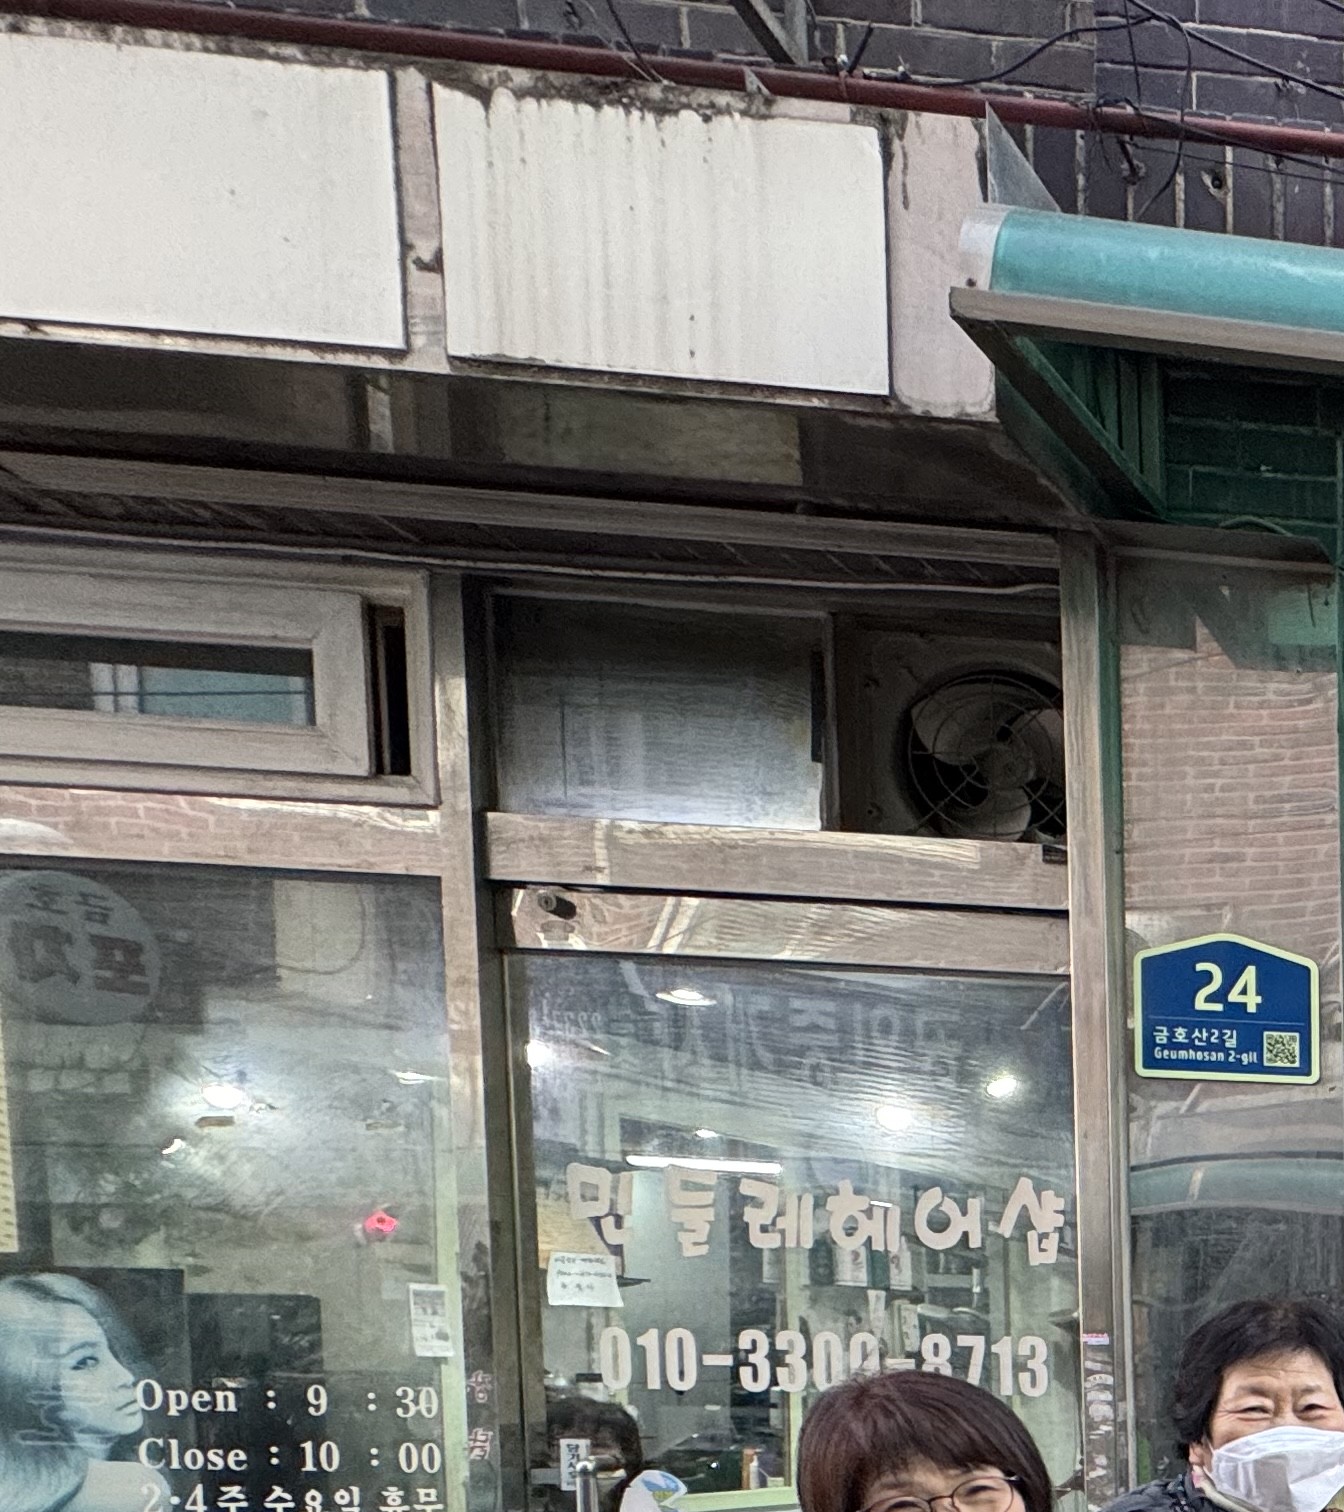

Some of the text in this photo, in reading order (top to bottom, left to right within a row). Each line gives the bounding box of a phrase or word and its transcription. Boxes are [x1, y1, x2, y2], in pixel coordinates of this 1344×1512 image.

[1194, 962, 1262, 1013] 24
[1152, 1026, 1238, 1048] 금호산2길
[1153, 1048, 1258, 1066] Geumhosan 2-gil
[136, 1378, 239, 1416] Open
[307, 1384, 329, 1417] 9
[395, 1386, 440, 1419] 30
[138, 1438, 249, 1472] Close
[300, 1441, 341, 1473] 10
[398, 1442, 442, 1474] 00
